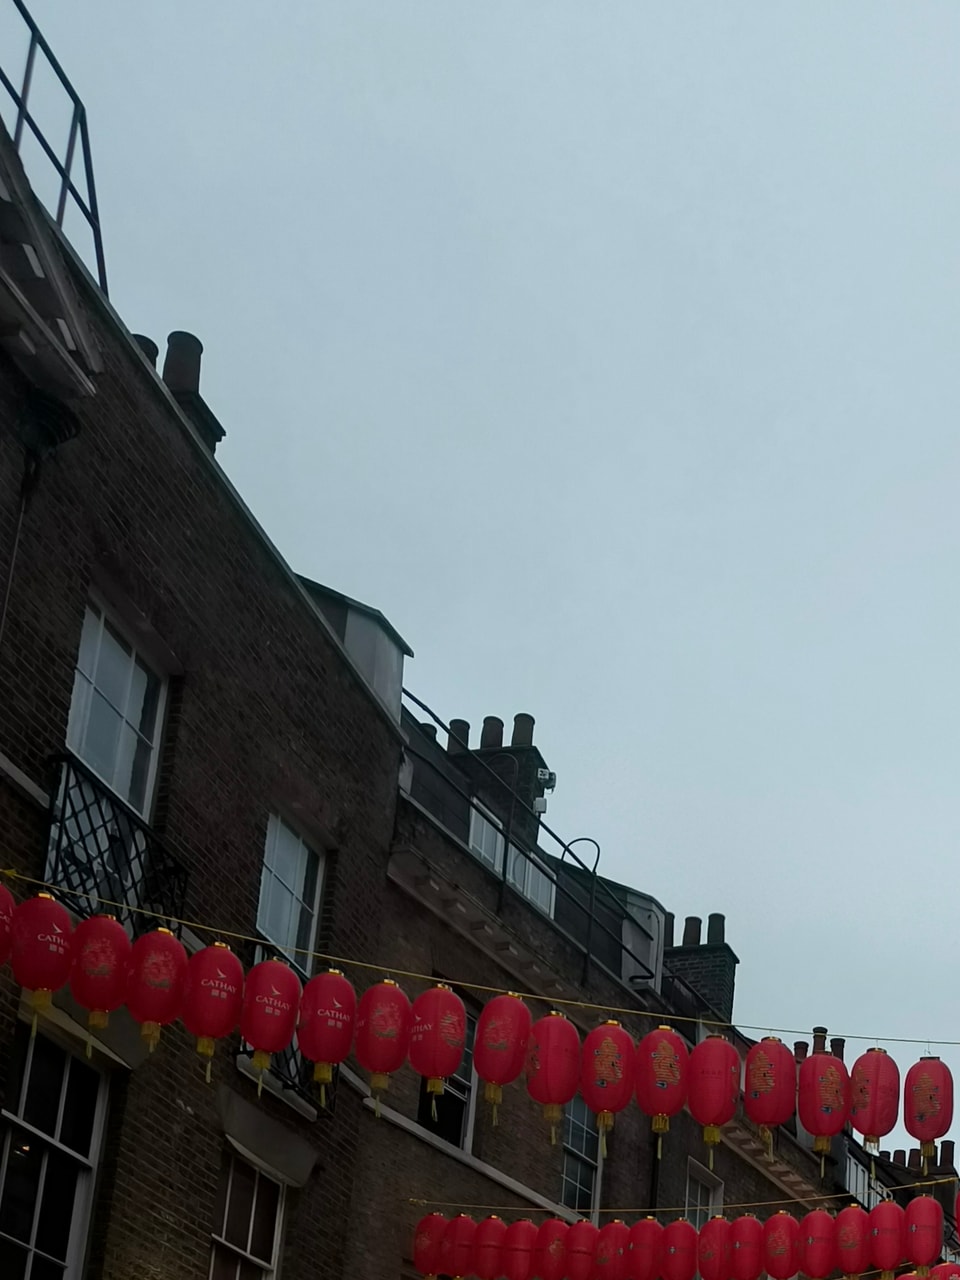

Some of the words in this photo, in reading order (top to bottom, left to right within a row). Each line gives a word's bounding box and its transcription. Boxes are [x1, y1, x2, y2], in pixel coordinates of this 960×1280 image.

[201, 978, 237, 995] CATHAY
[255, 995, 291, 1011] CATHAY
[317, 1008, 351, 1022] CATHAY
